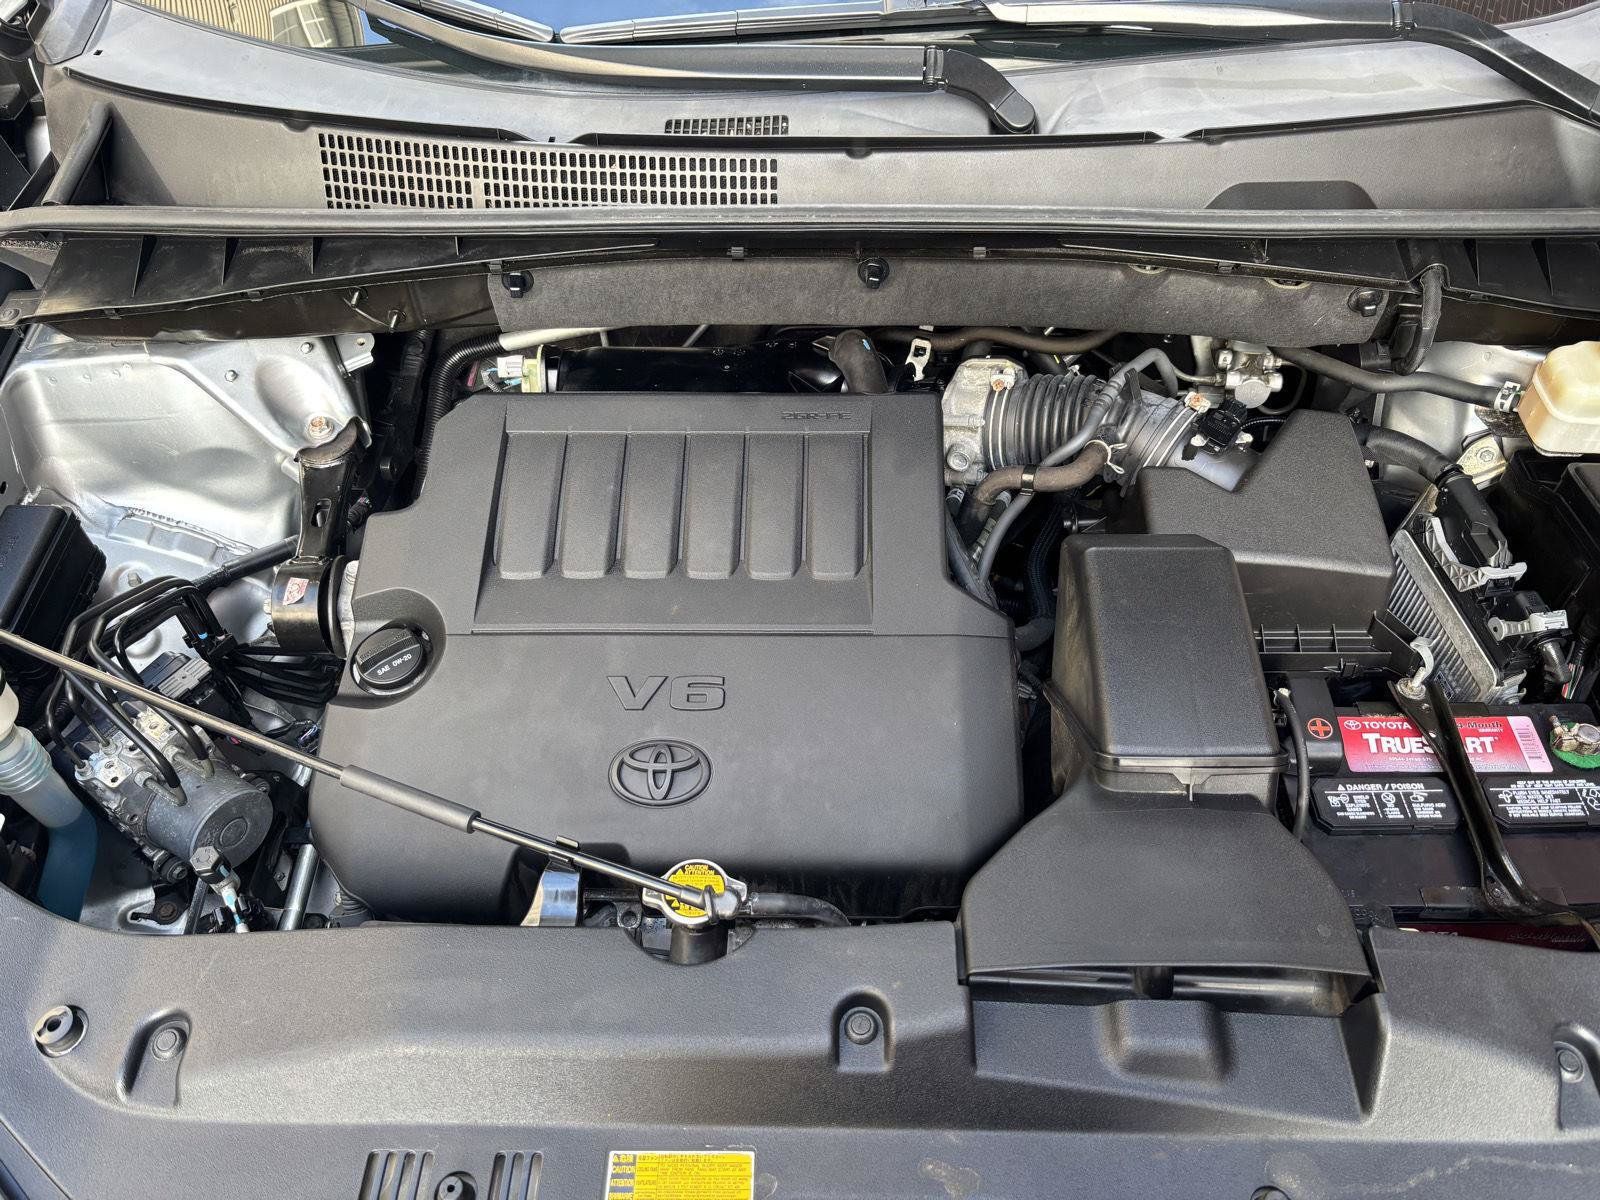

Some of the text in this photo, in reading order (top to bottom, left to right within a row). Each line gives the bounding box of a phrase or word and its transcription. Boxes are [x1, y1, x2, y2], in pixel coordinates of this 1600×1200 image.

[377, 653, 412, 676] SAE 0W-20
[606, 675, 726, 711] V6
[1362, 721, 1412, 730] TOYOTA
[1346, 783, 1383, 791] DANGER
[1391, 782, 1425, 791] POISON
[612, 1165, 636, 1174] CAUTION
